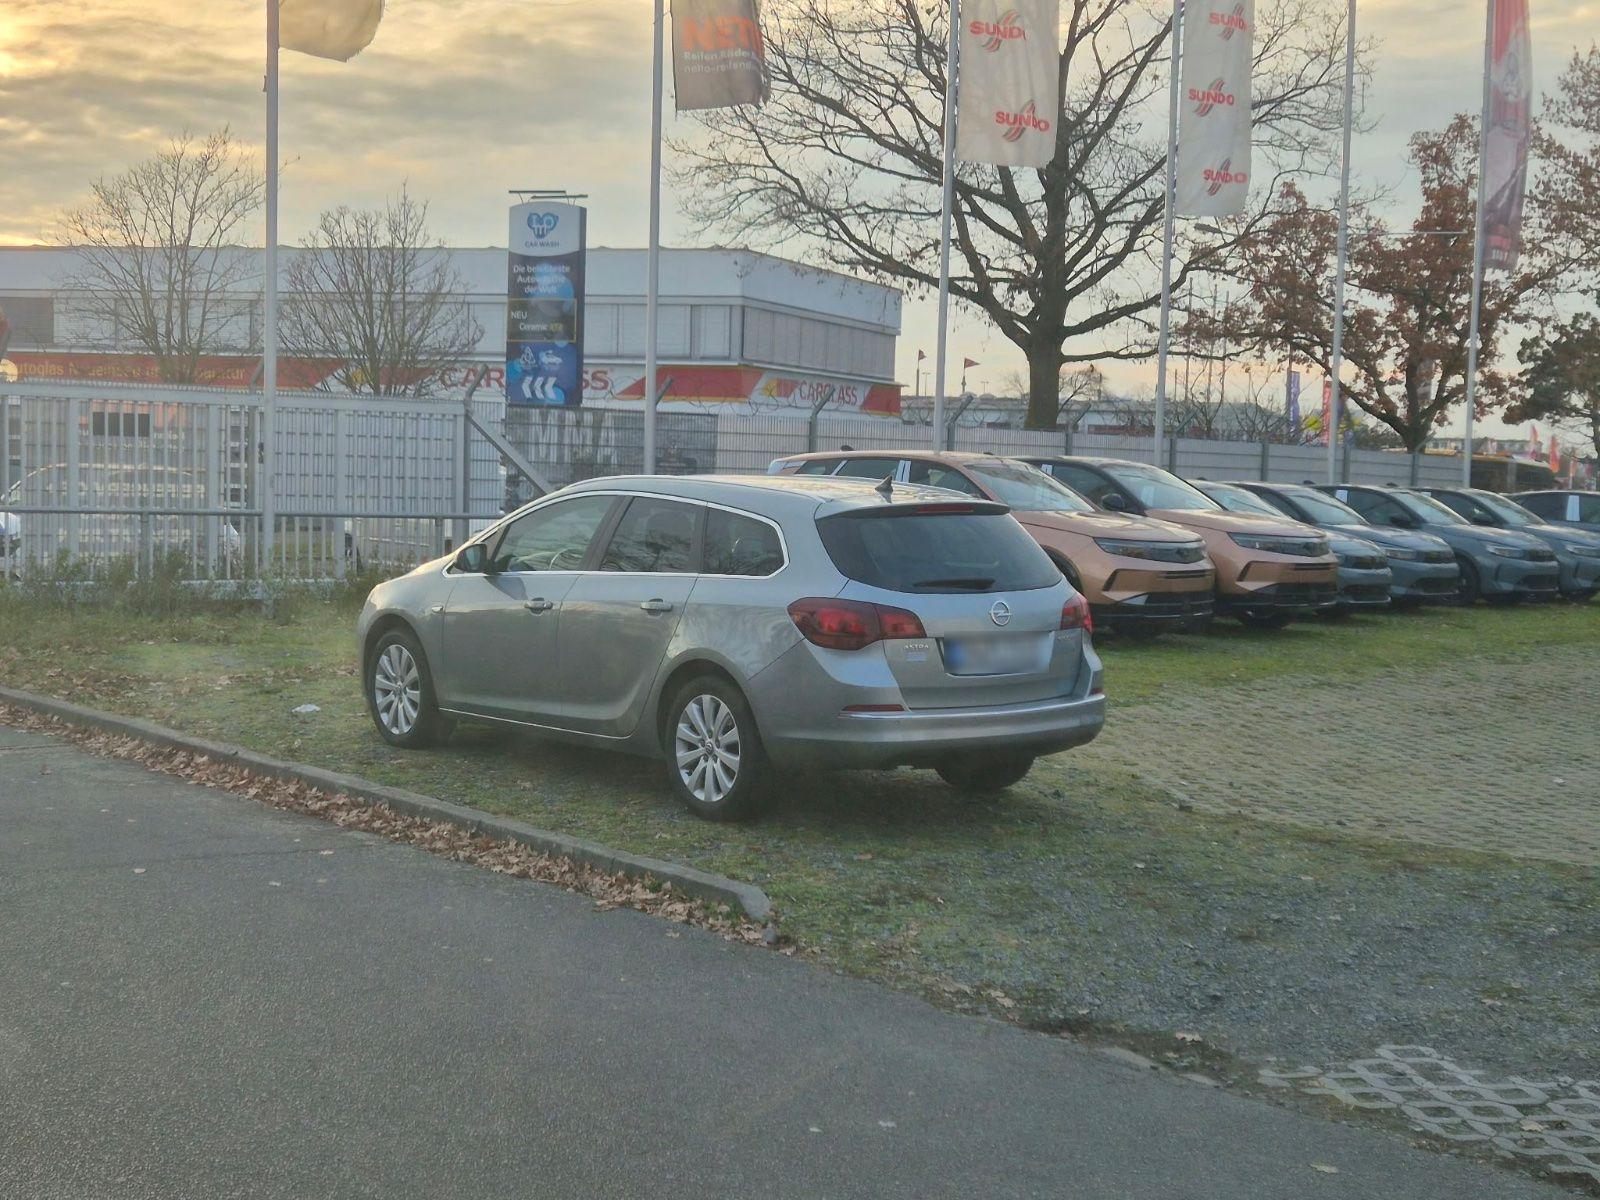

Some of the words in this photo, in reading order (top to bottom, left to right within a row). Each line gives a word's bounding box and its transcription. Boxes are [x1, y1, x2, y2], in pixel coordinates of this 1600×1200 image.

[969, 20, 1026, 41] SUND
[1188, 88, 1235, 106] SUNDO
[995, 111, 1050, 132] SUNDO
[1203, 169, 1248, 183] SUNDO
[525, 241, 539, 249] CAR
[539, 241, 560, 249] WASH
[513, 264, 525, 273] Die
[511, 311, 528, 320] NEU
[519, 322, 548, 332] Ceramic
[17, 361, 64, 376] utoglas
